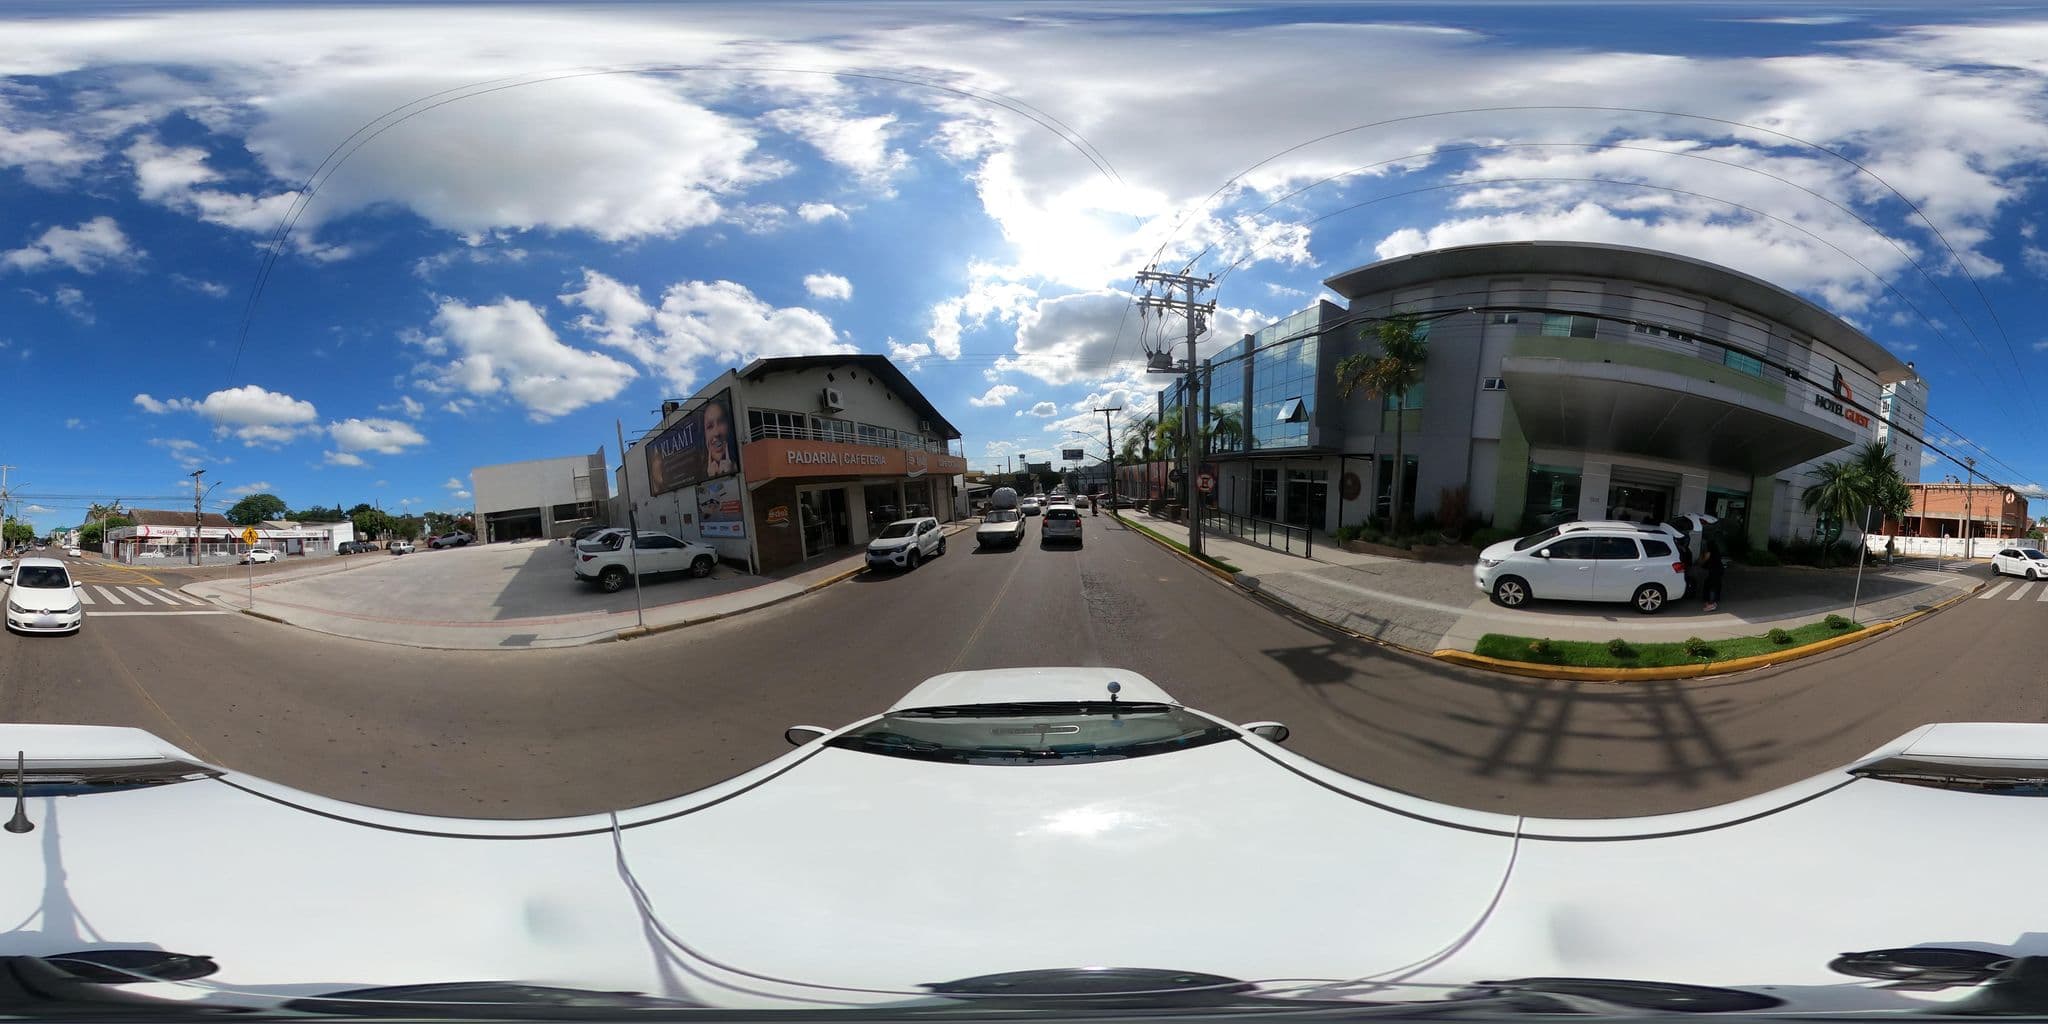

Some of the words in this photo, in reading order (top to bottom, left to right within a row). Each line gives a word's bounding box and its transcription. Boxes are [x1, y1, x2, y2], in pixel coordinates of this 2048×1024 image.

[1815, 394, 1844, 417] HOTEL
[1845, 408, 1870, 428] GUEST
[660, 423, 694, 459] KLAMT
[787, 450, 838, 464] PADARIA
[843, 453, 887, 465] CAFETERIA
